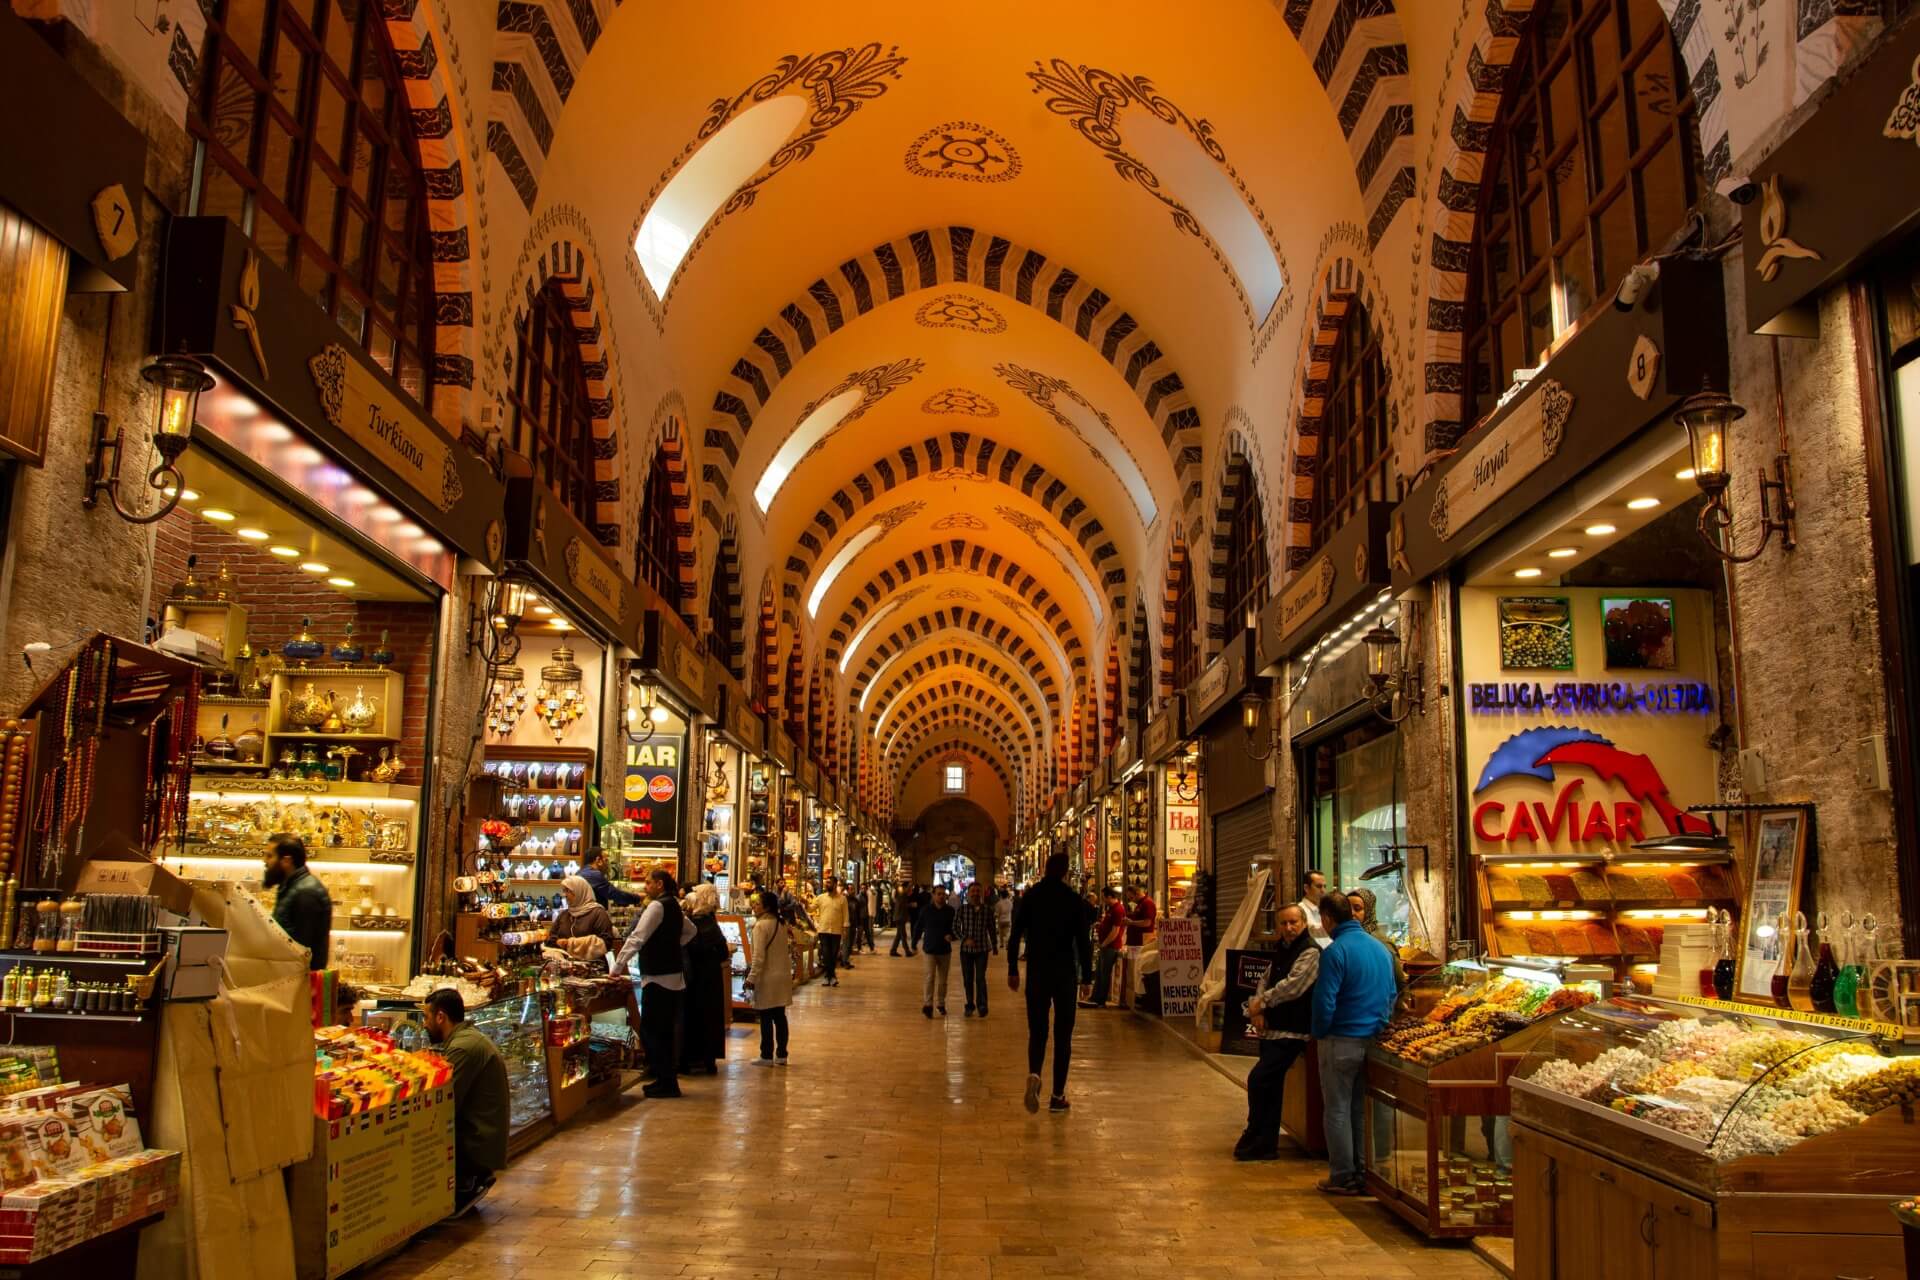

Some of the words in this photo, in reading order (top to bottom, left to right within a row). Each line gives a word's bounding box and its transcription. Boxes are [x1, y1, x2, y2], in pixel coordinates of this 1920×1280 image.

[112, 202, 126, 236] 7
[1637, 352, 1646, 381] 8
[368, 403, 424, 472] Turkiana
[1472, 439, 1510, 492] Hayat
[1472, 778, 1647, 844] CAVIAR
[1159, 920, 1193, 932] PIRLANTA
